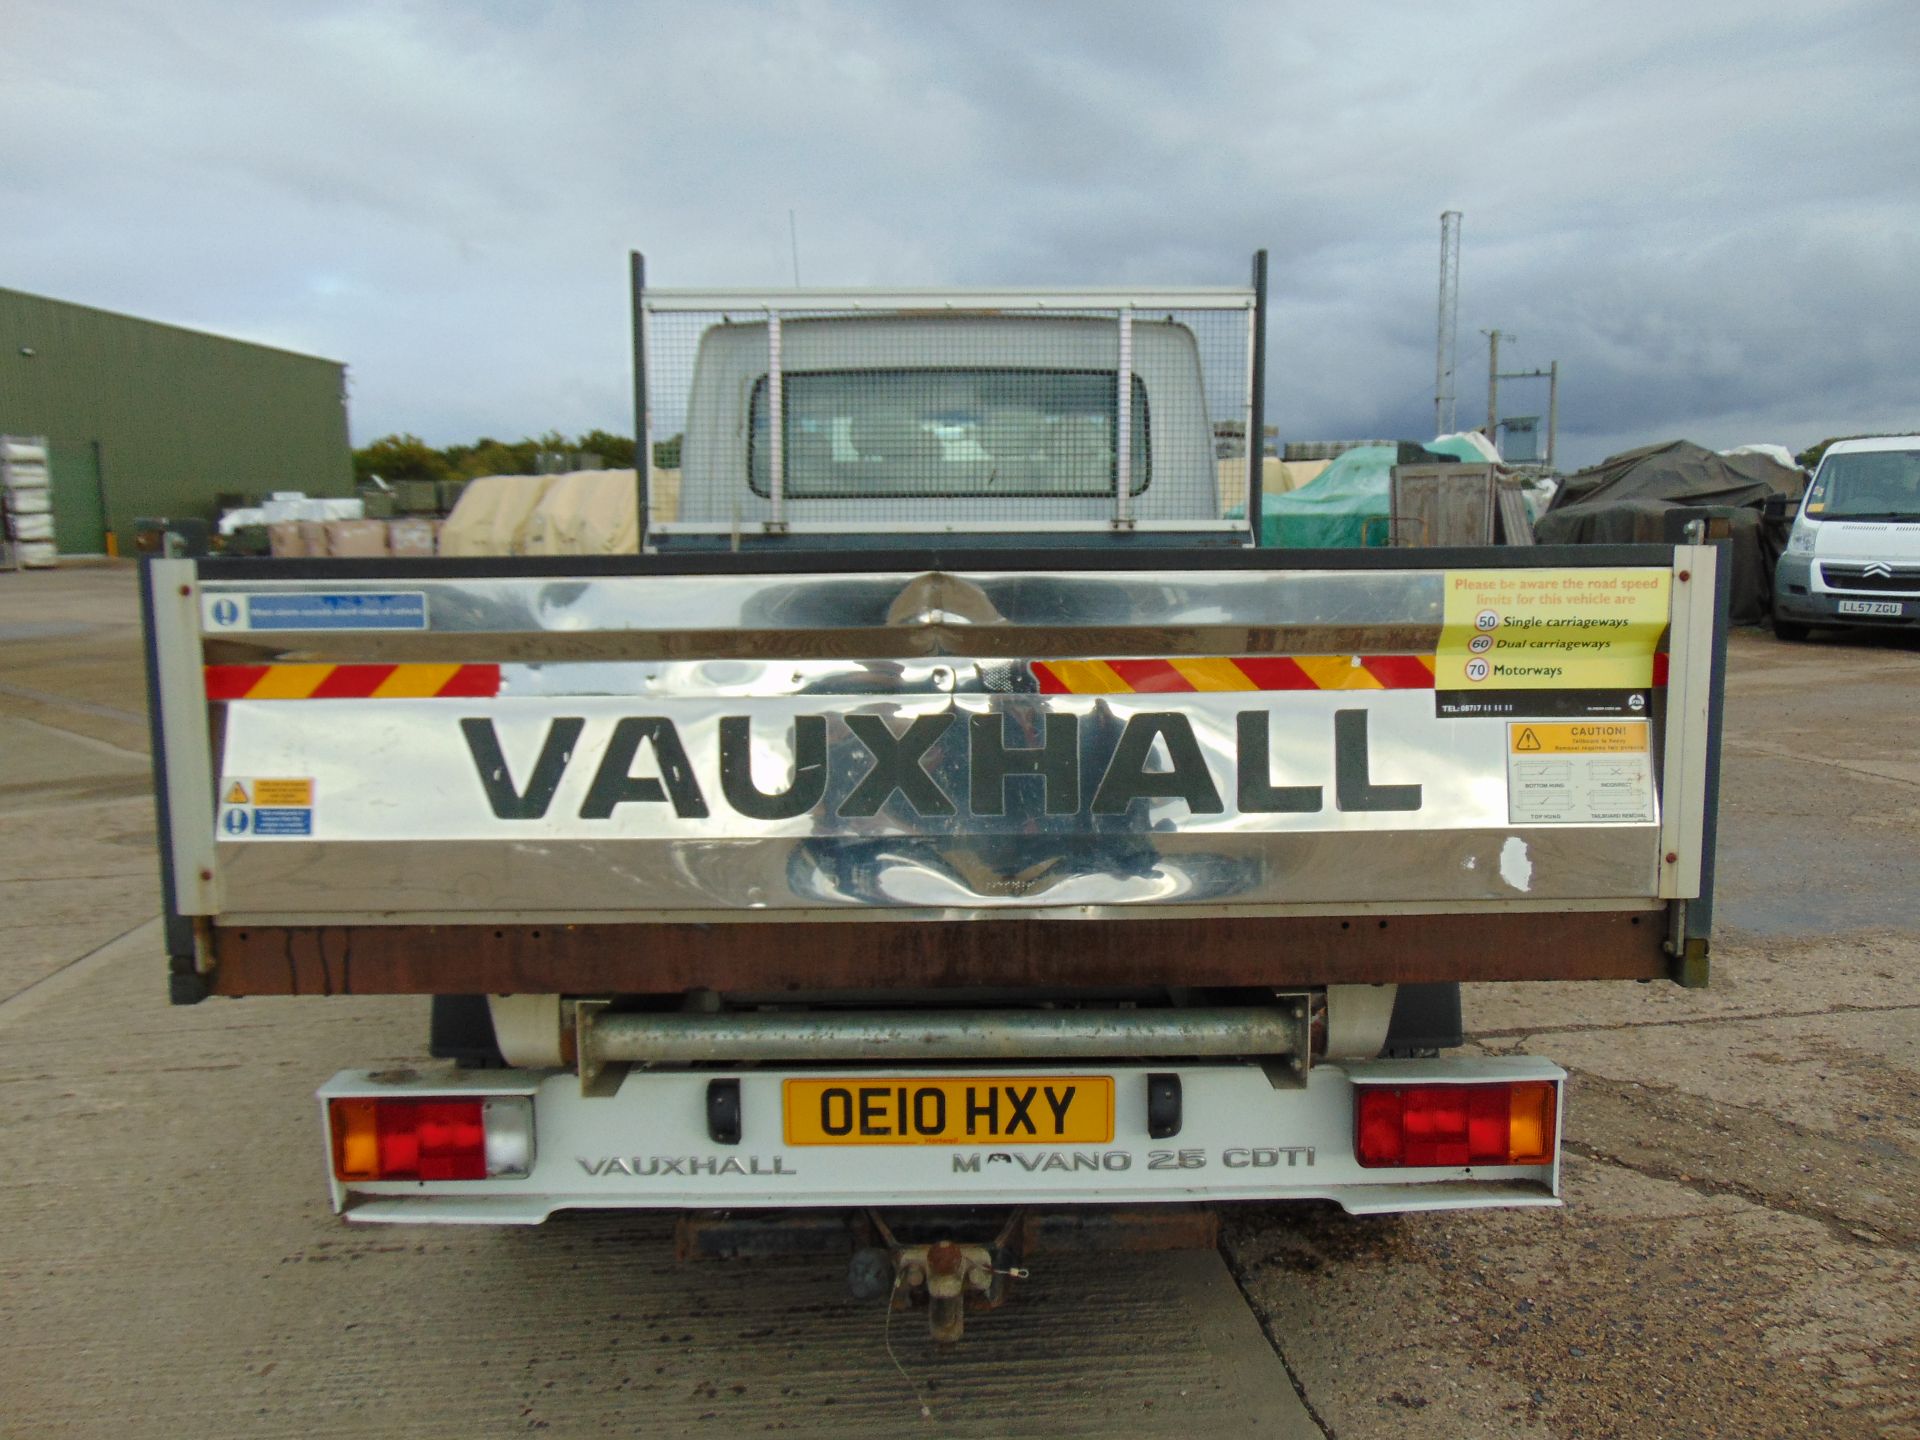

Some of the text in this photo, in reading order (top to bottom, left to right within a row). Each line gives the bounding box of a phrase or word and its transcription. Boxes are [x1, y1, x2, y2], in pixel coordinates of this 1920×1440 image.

[1455, 578, 1659, 591] Please be aware the road speed
[1477, 593, 1636, 605] limits for this vehicle are
[1843, 602, 1898, 614] LL57 ZGU
[1479, 615, 1630, 630] 50 Single carriageways
[1472, 639, 1611, 651] 60 Dual carriageways
[1469, 664, 1563, 679] 70 Motorways
[1571, 726, 1627, 736] CAUTION!
[459, 710, 1423, 821] VAUXHALL
[966, 1086, 1076, 1135] HXY
[575, 1155, 797, 1176] VAUXHALL
[1147, 1149, 1208, 1171] 25
